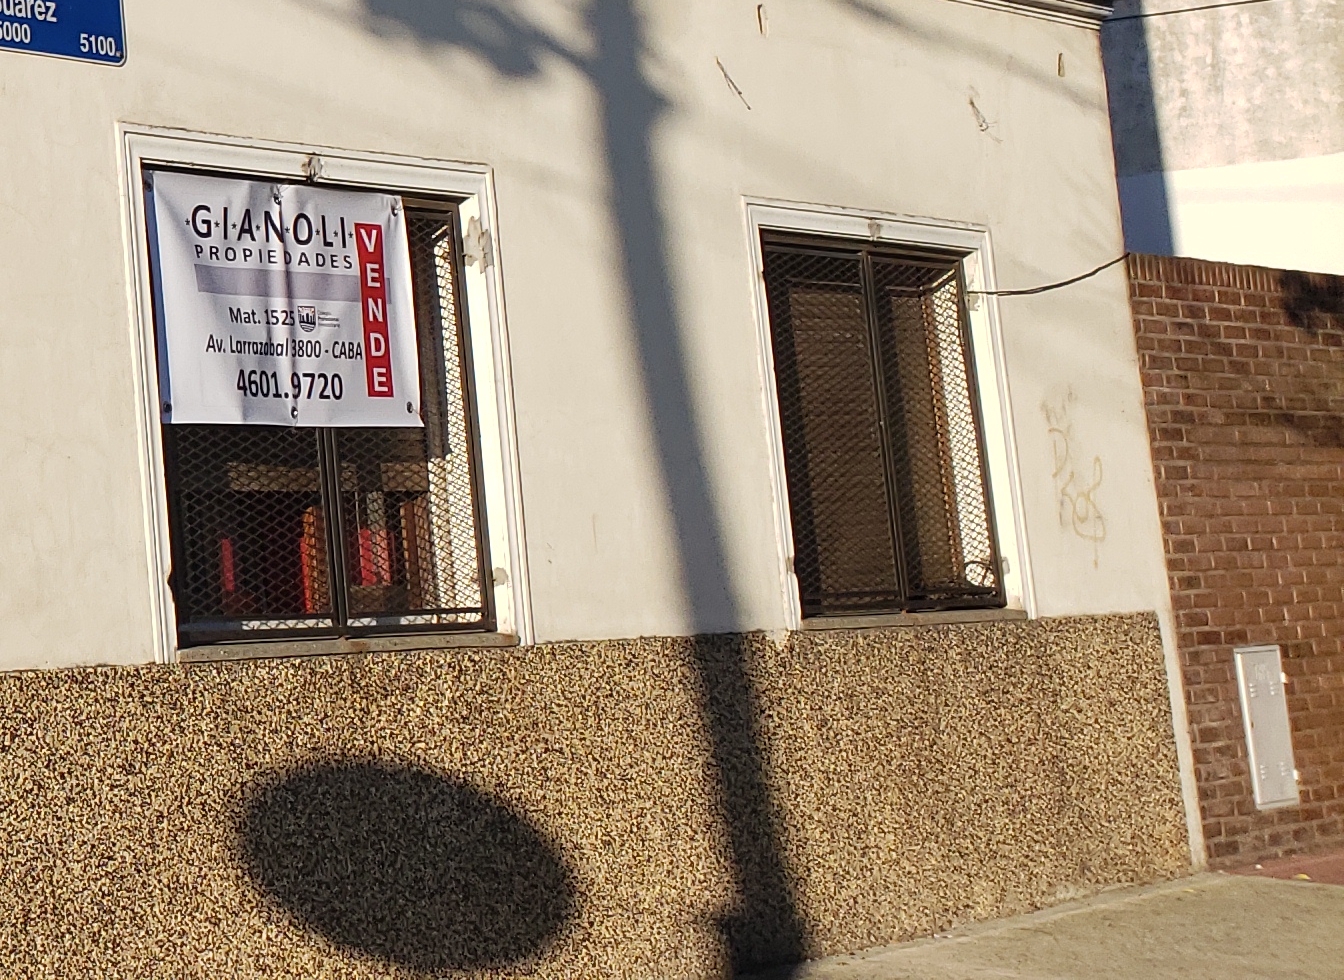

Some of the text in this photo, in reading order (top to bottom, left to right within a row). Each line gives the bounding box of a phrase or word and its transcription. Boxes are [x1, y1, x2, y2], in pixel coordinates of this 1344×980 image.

[79, 33, 116, 57] 5100
[194, 245, 353, 269] PROPIEDADES
[228, 306, 261, 325] Mat.
[264, 309, 295, 327] 1525
[359, 228, 389, 393] VENDE
[206, 334, 226, 353] Av.
[230, 335, 289, 357] Larrazabal
[291, 339, 322, 358] 3800
[332, 340, 363, 360] CABA
[237, 368, 343, 401] 4601.9720
